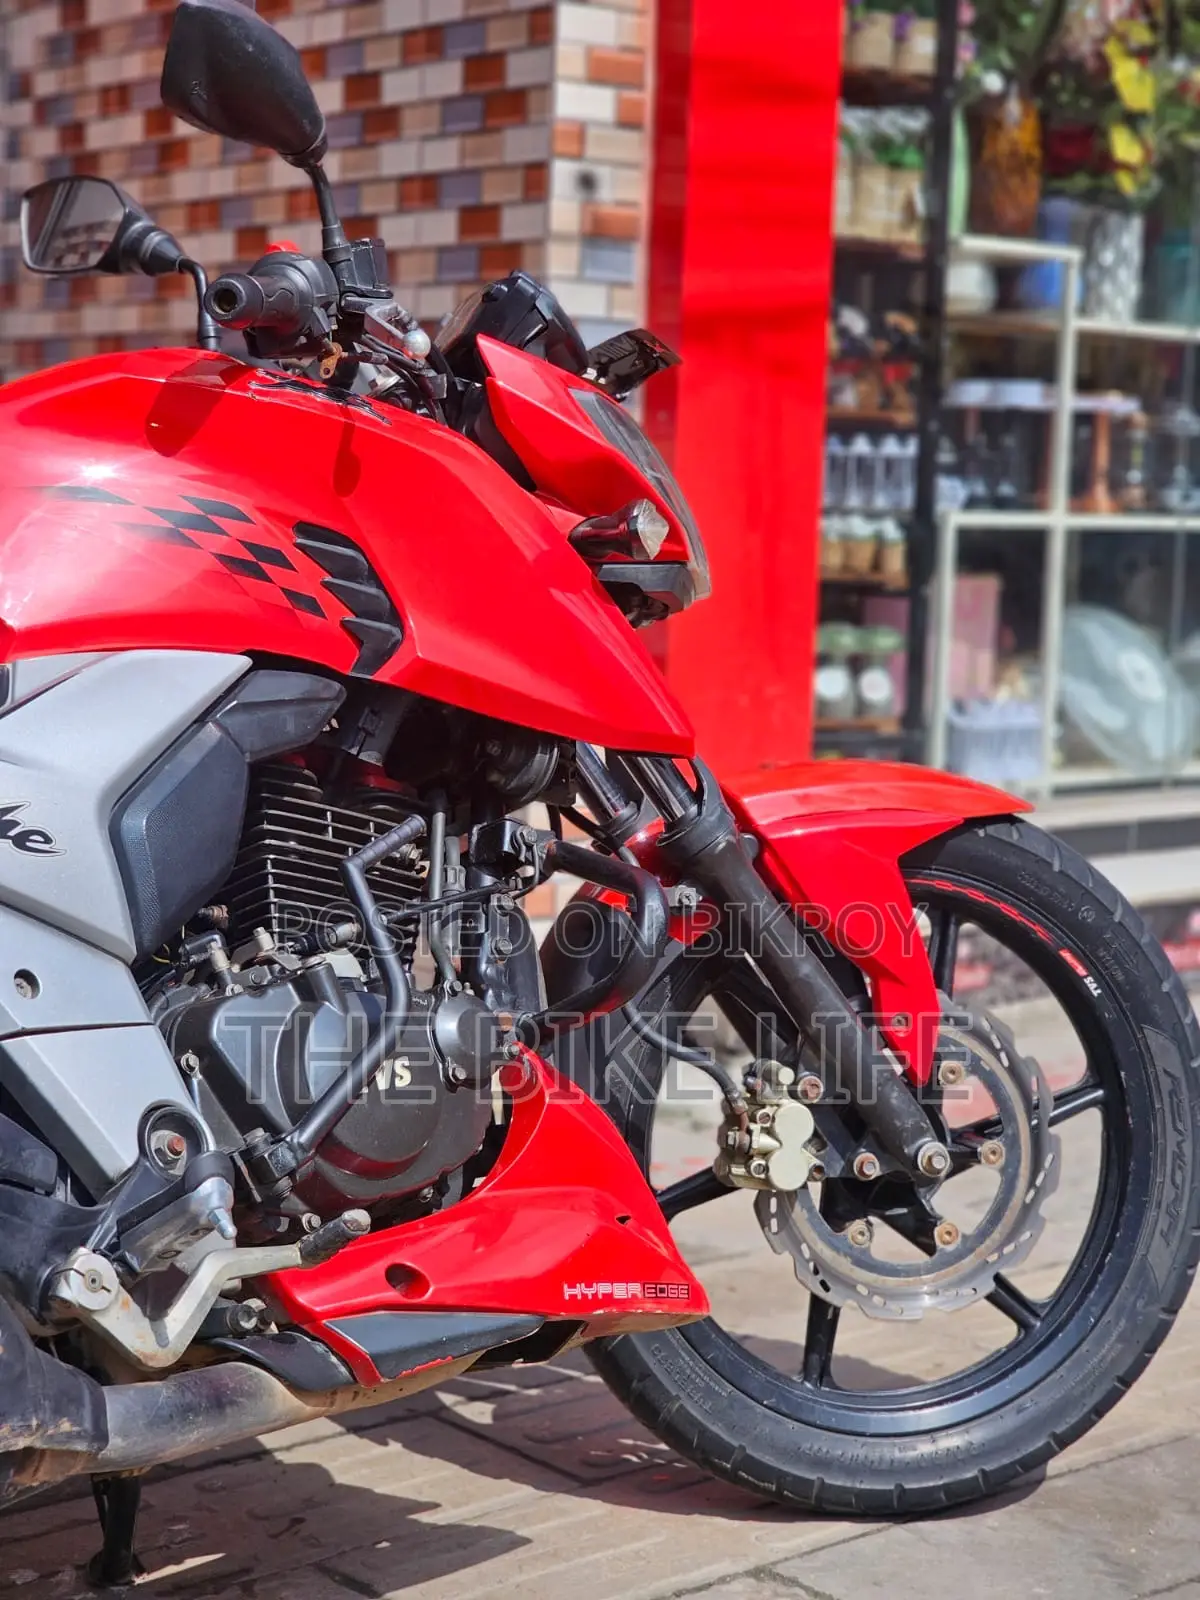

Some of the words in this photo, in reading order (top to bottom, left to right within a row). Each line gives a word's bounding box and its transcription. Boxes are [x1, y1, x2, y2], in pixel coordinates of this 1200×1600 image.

[1083, 976, 1103, 998] TVS
[360, 1056, 411, 1093] VS
[563, 1282, 642, 1300] HYPER
[644, 1282, 690, 1300] EDGE
